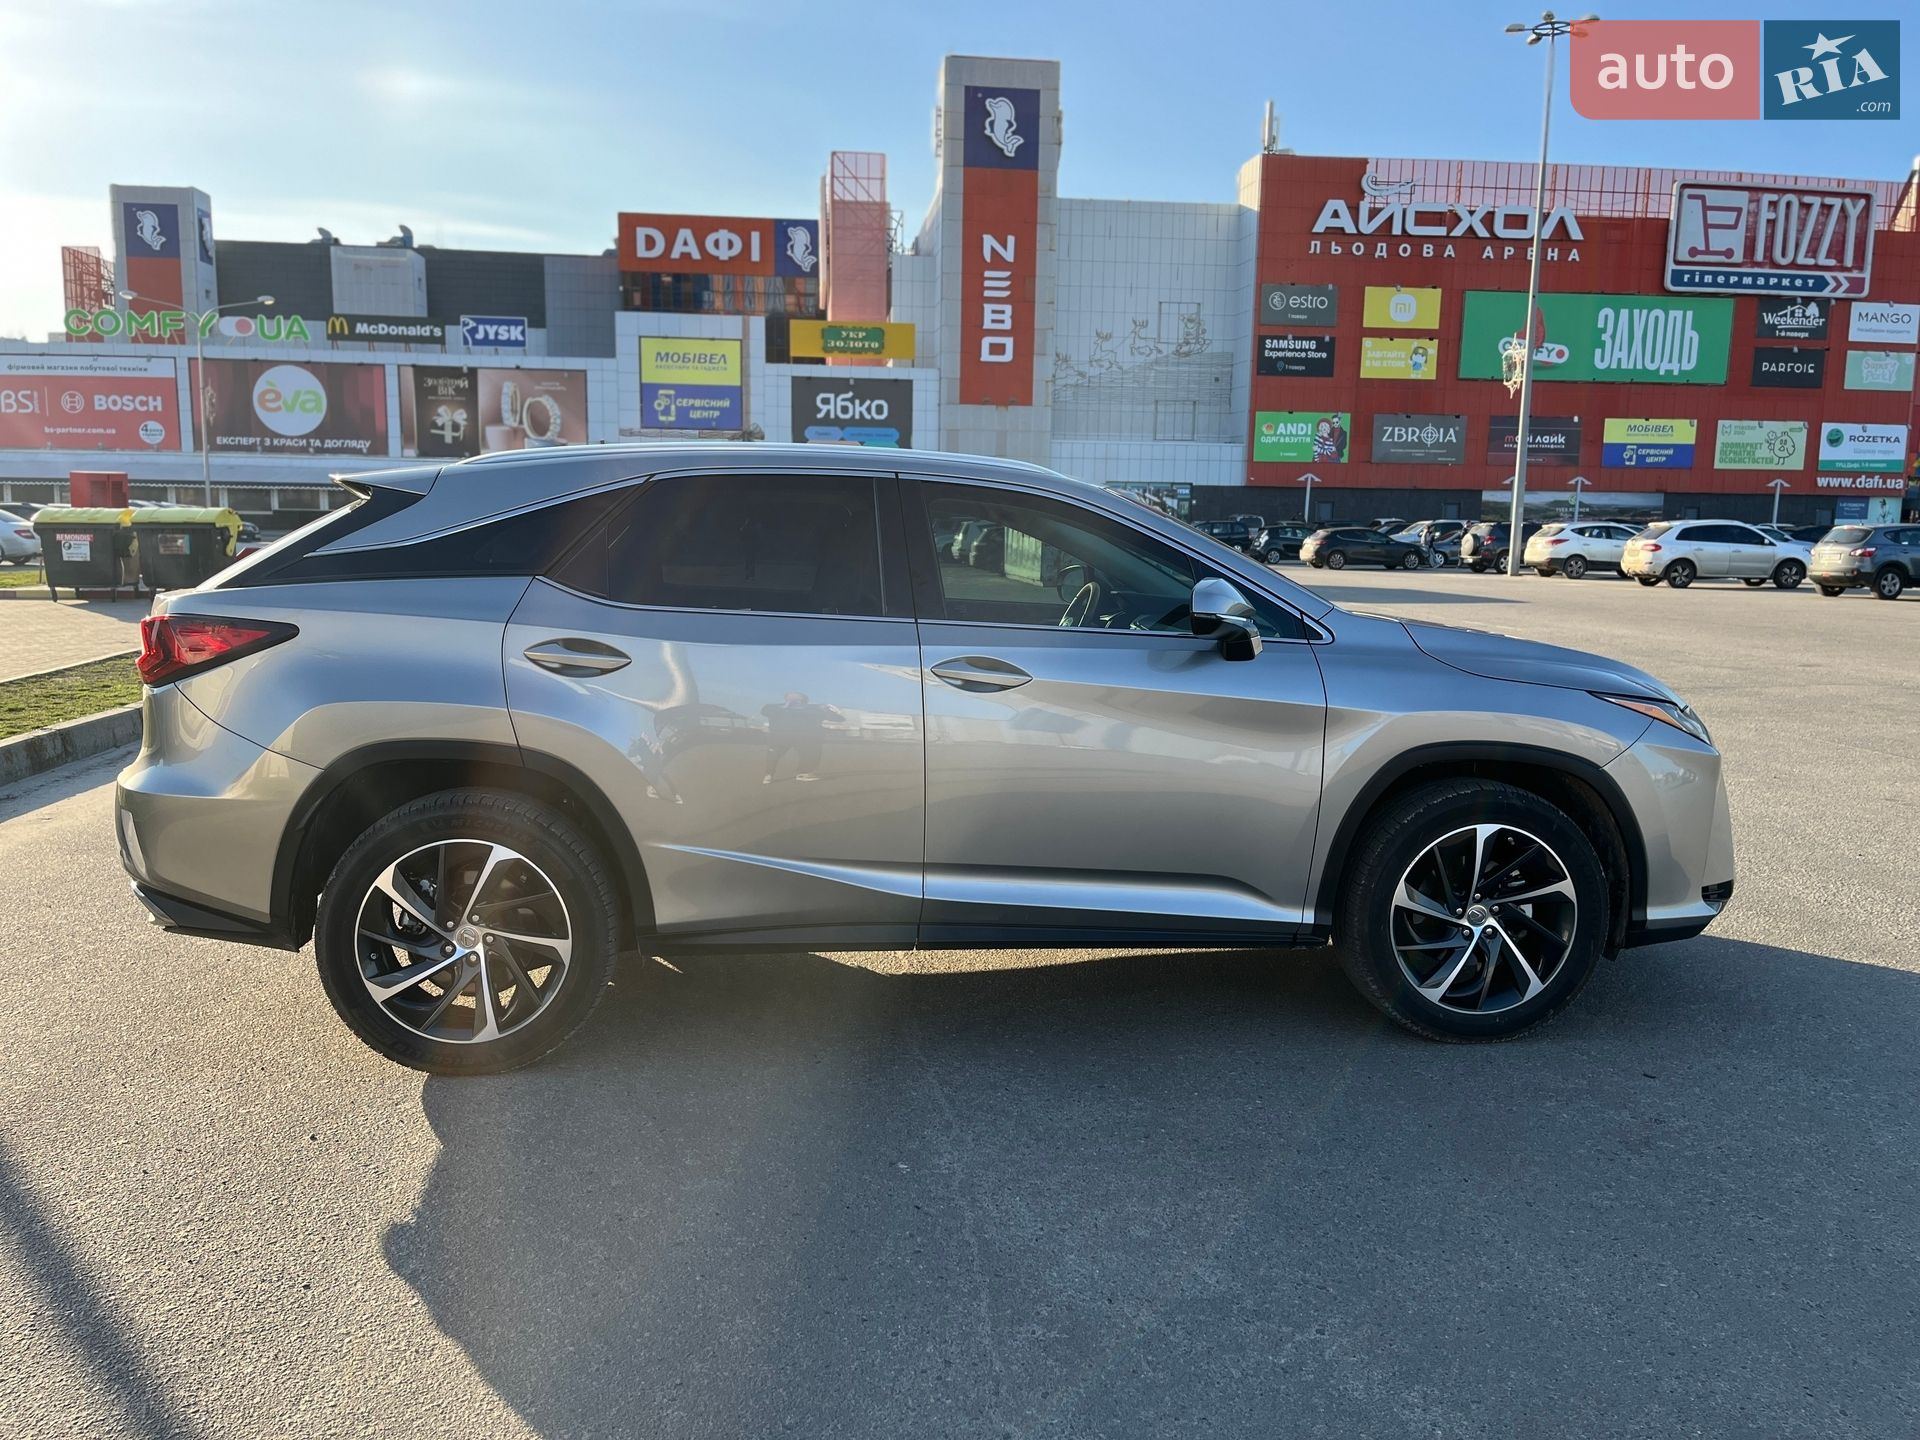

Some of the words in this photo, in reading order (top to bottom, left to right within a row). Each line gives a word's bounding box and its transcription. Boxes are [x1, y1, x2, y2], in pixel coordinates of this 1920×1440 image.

[1312, 180, 1584, 241] АЙСХОЛ
[1754, 193, 1866, 267] FOZZY
[1309, 241, 1456, 258] ЛЬОДОВА
[1684, 272, 1815, 287] гіпермаркет
[1289, 295, 1328, 309] estro
[1762, 309, 1826, 326] Weekender
[1858, 312, 1912, 324] MANGO
[64, 308, 219, 337] COMFY
[257, 314, 310, 342] UA
[355, 322, 443, 337] McDonald's
[474, 324, 525, 341] JYSK
[828, 340, 879, 348] ЗОЛОТО
[1265, 339, 1317, 349] SAMSUNG
[1594, 307, 1700, 375] ЗАХОДЬ
[655, 352, 727, 364] МОБІВЕЛ
[1265, 350, 1306, 359] Experience
[1762, 362, 1815, 373] PARFOIS
[94, 395, 162, 412] BOSCH
[676, 398, 730, 408] СЕРВІСНИЙ
[816, 391, 888, 420] Ябко
[689, 410, 720, 419] ЦЕНТР
[44, 426, 116, 435] bs-partner.com.ua
[1277, 423, 1312, 435] ANDI
[216, 437, 261, 445] ЕКСПЕРТ
[273, 438, 307, 447] КРАСИ
[309, 439, 322, 447] ТА
[324, 440, 371, 449] ДОГЛЯДУ
[1721, 442, 1763, 450] ЗООМАРКЕТ
[1849, 435, 1900, 444] ROZETKA
[1816, 475, 1904, 490] www.dafi.ua
